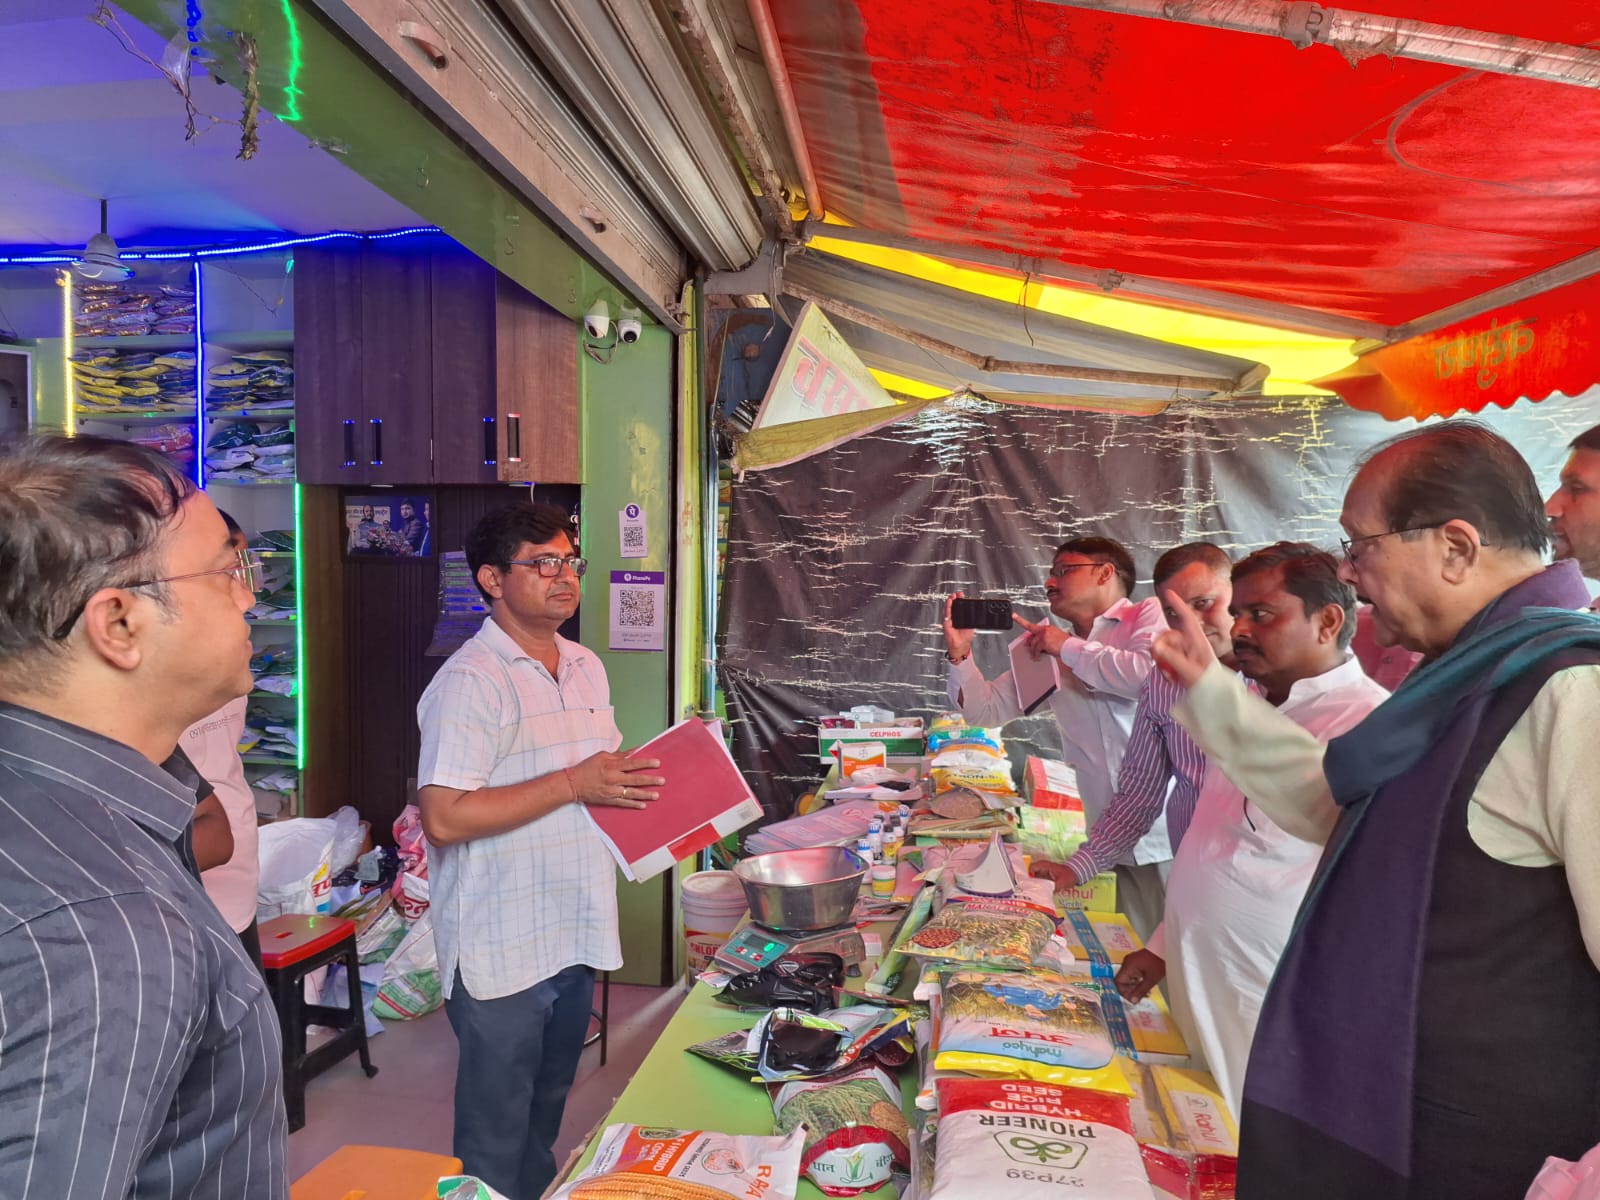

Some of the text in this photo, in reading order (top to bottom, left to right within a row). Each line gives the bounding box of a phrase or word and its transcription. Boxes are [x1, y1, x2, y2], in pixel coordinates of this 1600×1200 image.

[988, 1027, 1072, 1046] उपज
[1002, 1040, 1062, 1058] mahyco
[1001, 1084, 1063, 1097] SEED
[1006, 1092, 1062, 1105] RICE
[989, 1100, 1082, 1117] HYBRID
[979, 1114, 1097, 1139] PIONEER
